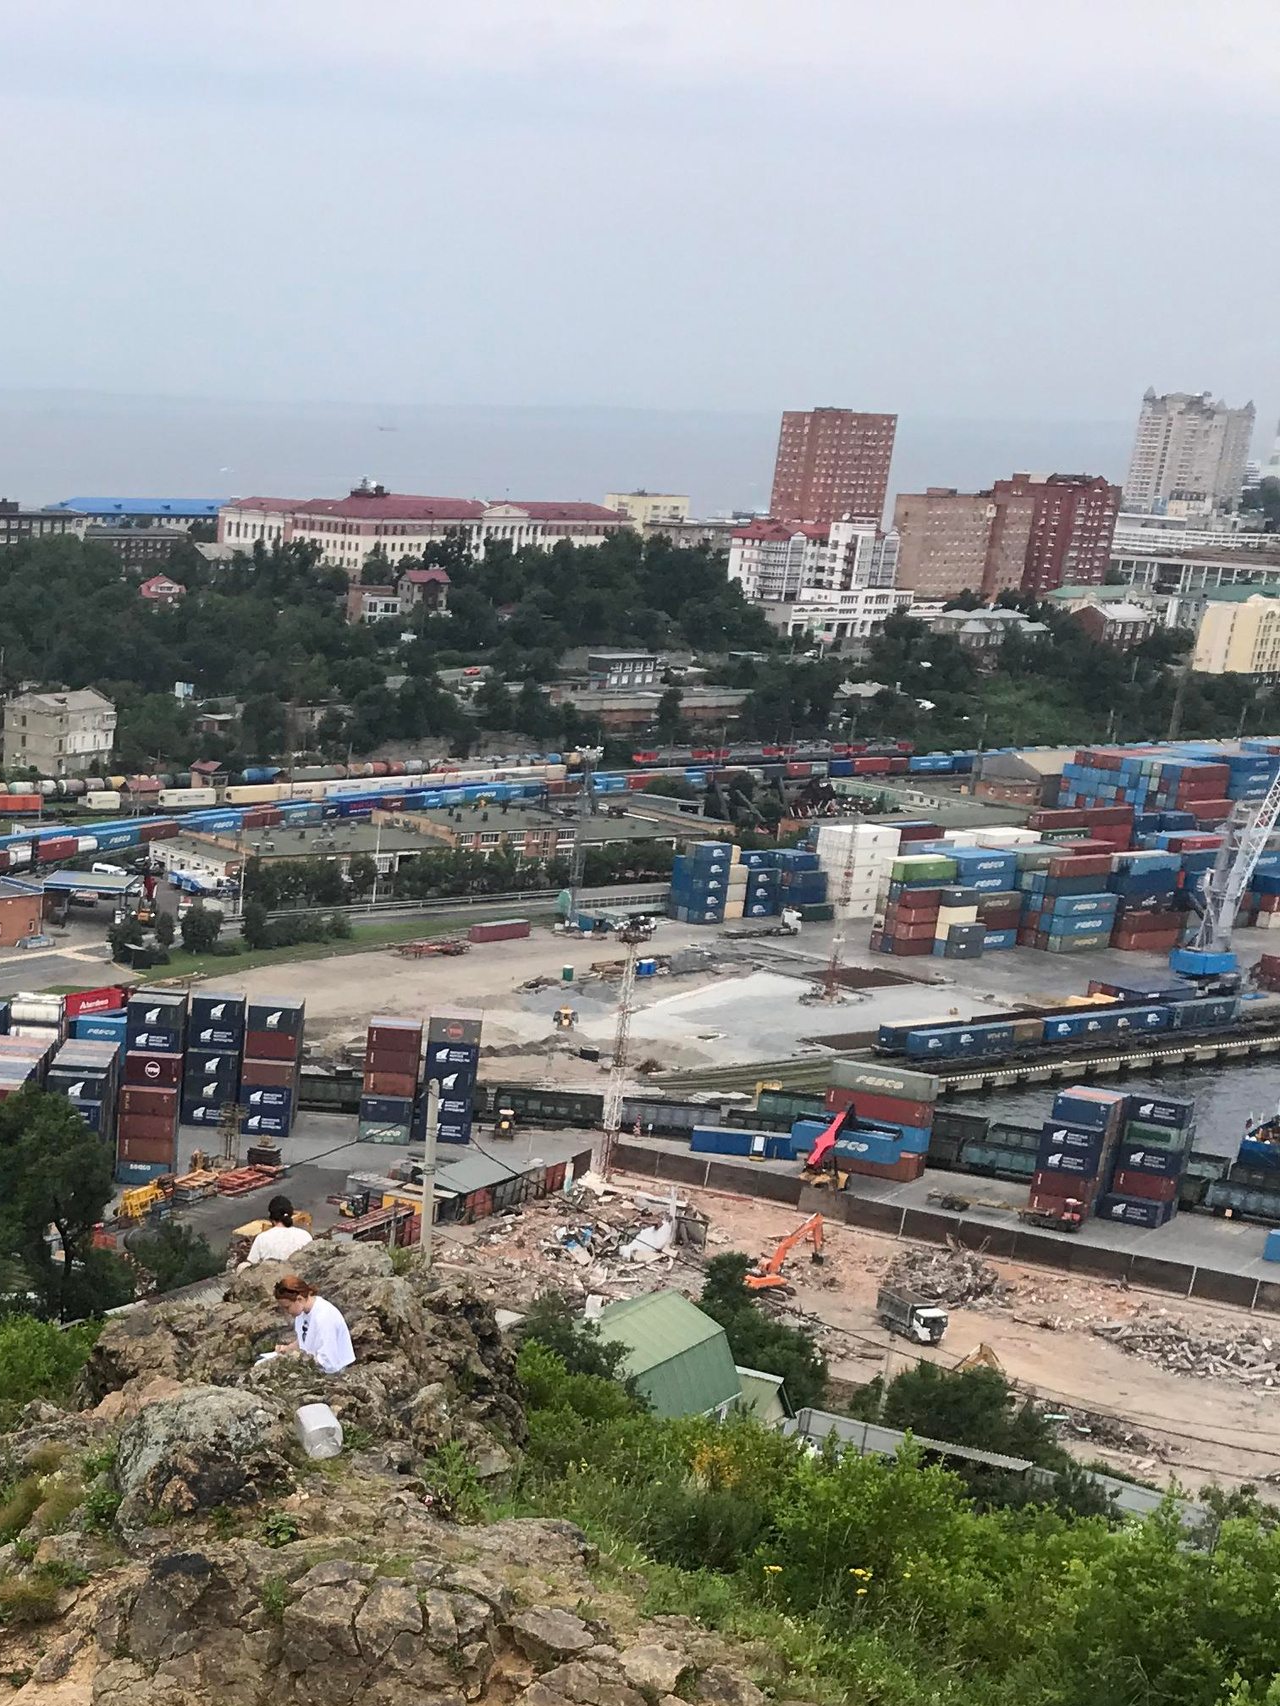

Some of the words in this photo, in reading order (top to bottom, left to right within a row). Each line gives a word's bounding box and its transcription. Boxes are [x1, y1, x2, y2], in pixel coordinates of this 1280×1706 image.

[292, 788, 313, 796] FESCO
[109, 834, 131, 844] FESCO
[974, 878, 1002, 888] FESCO
[1074, 920, 1103, 930] FESCO
[87, 1028, 117, 1036] FESCO
[856, 1074, 904, 1090] FESCO
[835, 1139, 869, 1152] SCO
